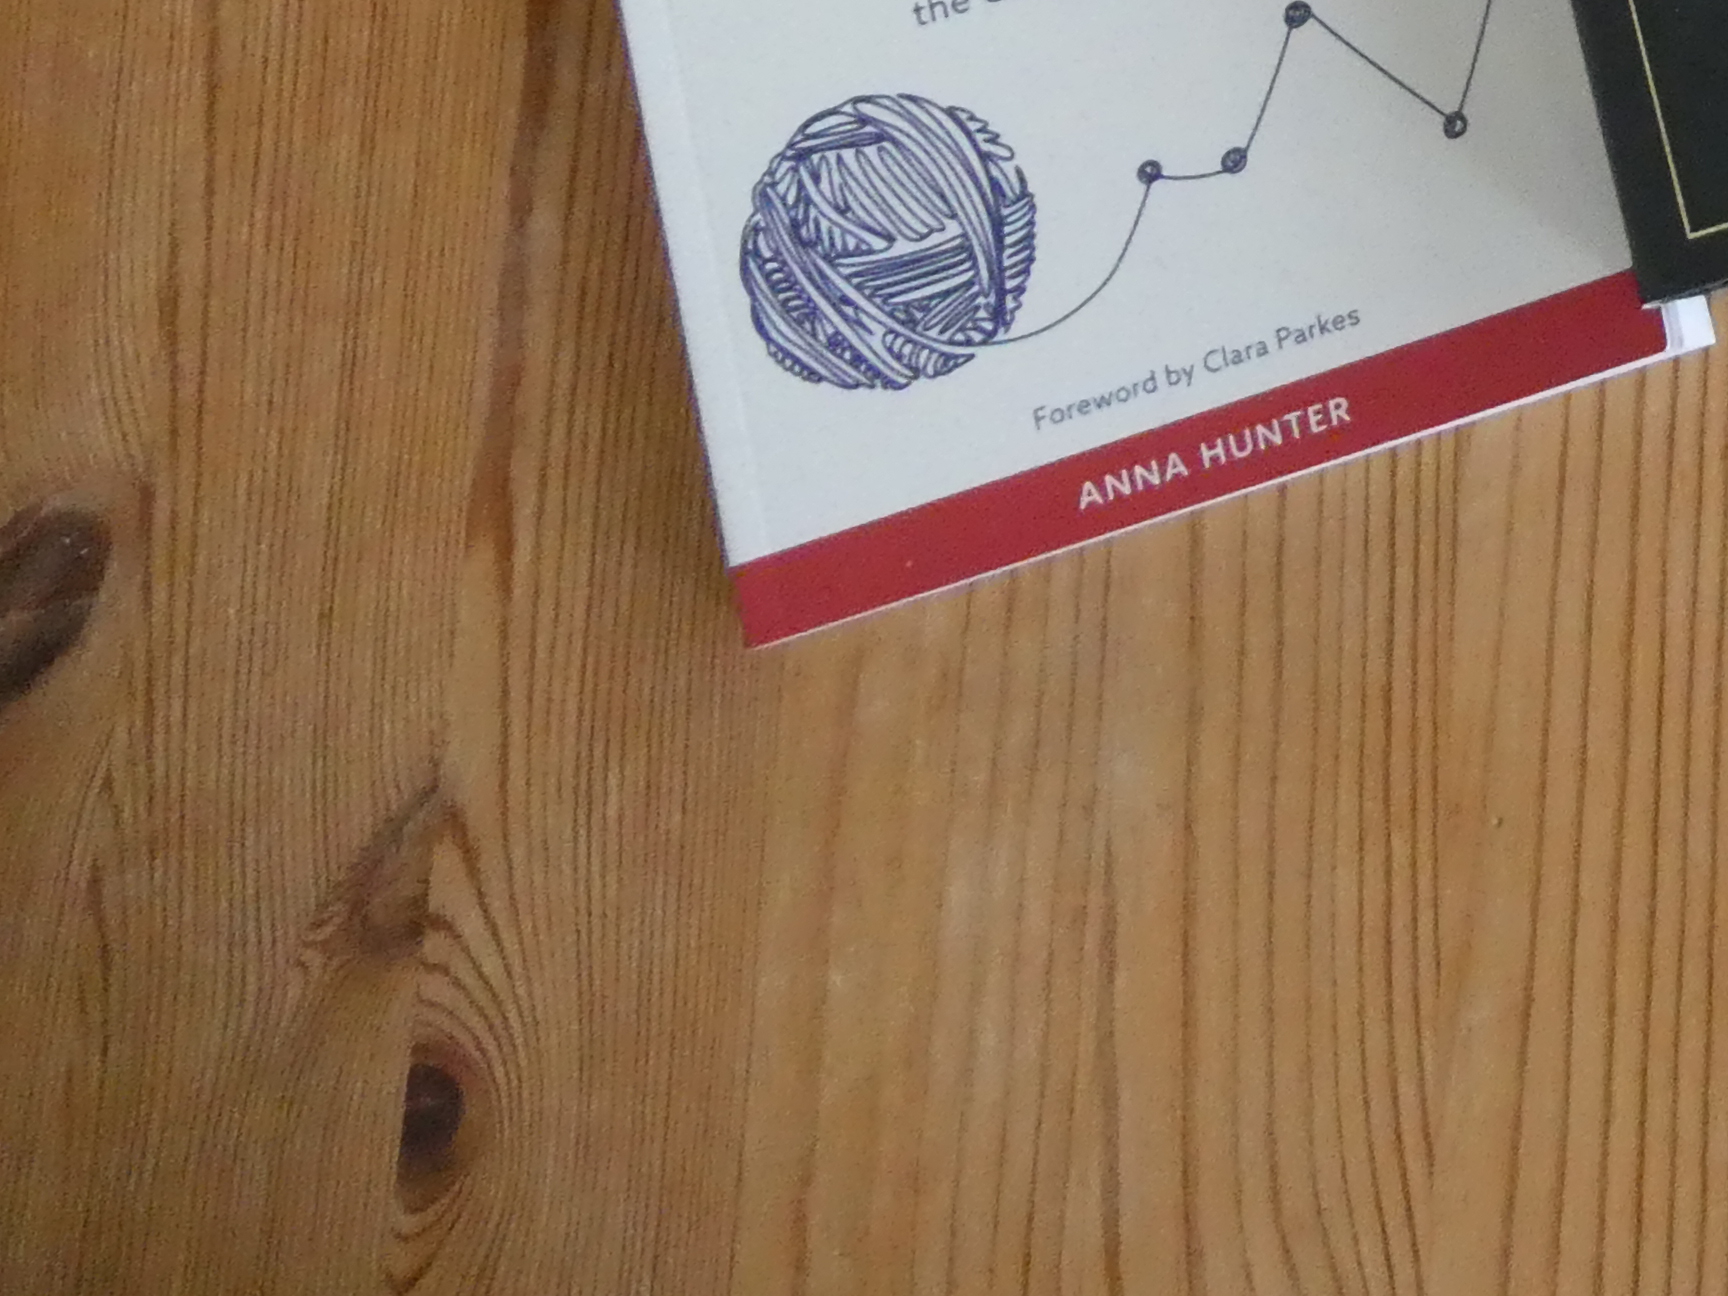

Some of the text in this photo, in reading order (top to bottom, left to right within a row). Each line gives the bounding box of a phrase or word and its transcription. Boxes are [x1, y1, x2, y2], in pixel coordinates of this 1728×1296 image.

[1032, 306, 1362, 431] Foreword by Clara Parkes
[1078, 396, 1352, 510] ANNA HUNTER
